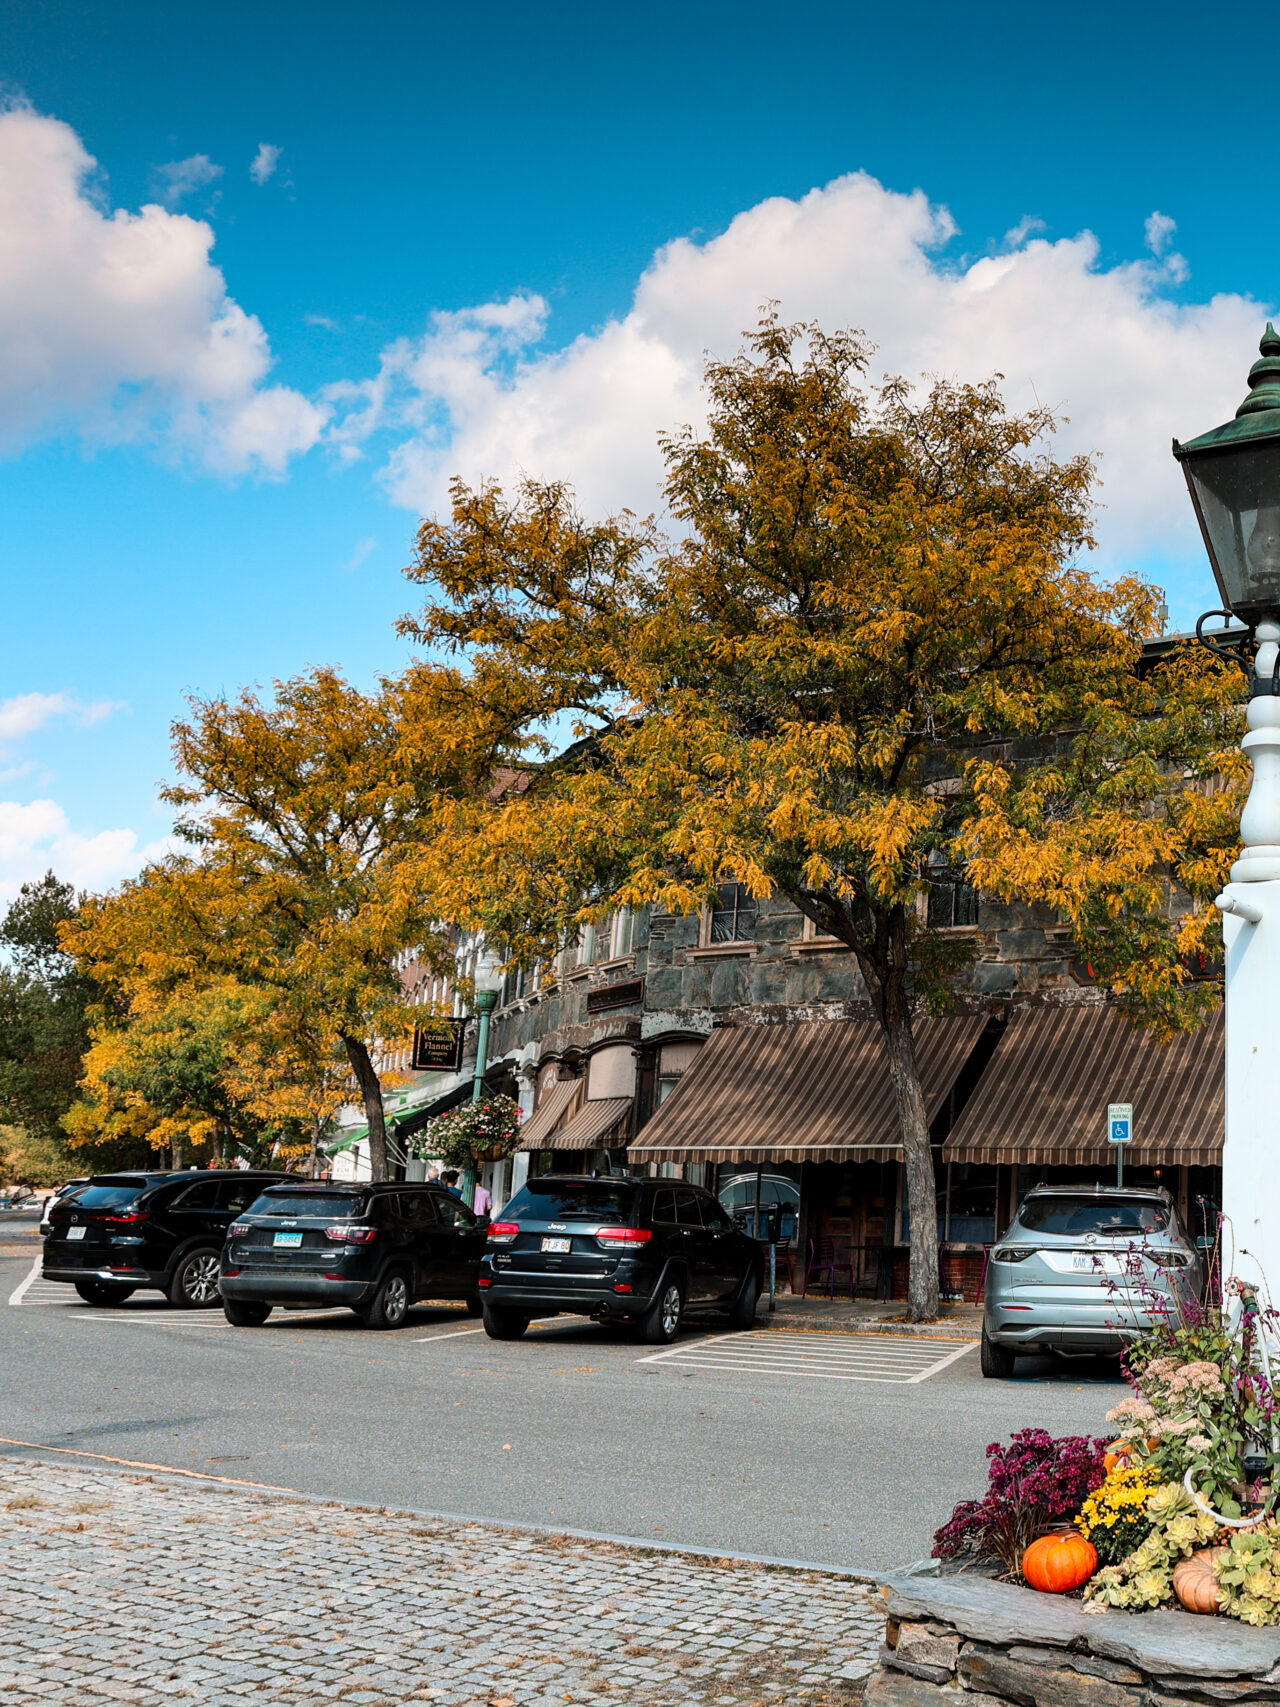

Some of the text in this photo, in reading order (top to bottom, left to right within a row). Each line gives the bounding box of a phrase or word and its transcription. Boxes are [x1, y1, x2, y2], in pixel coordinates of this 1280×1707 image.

[424, 1032, 452, 1042] Vermo
[424, 1041, 453, 1051] Flannel
[547, 1222, 567, 1231] Jeep
